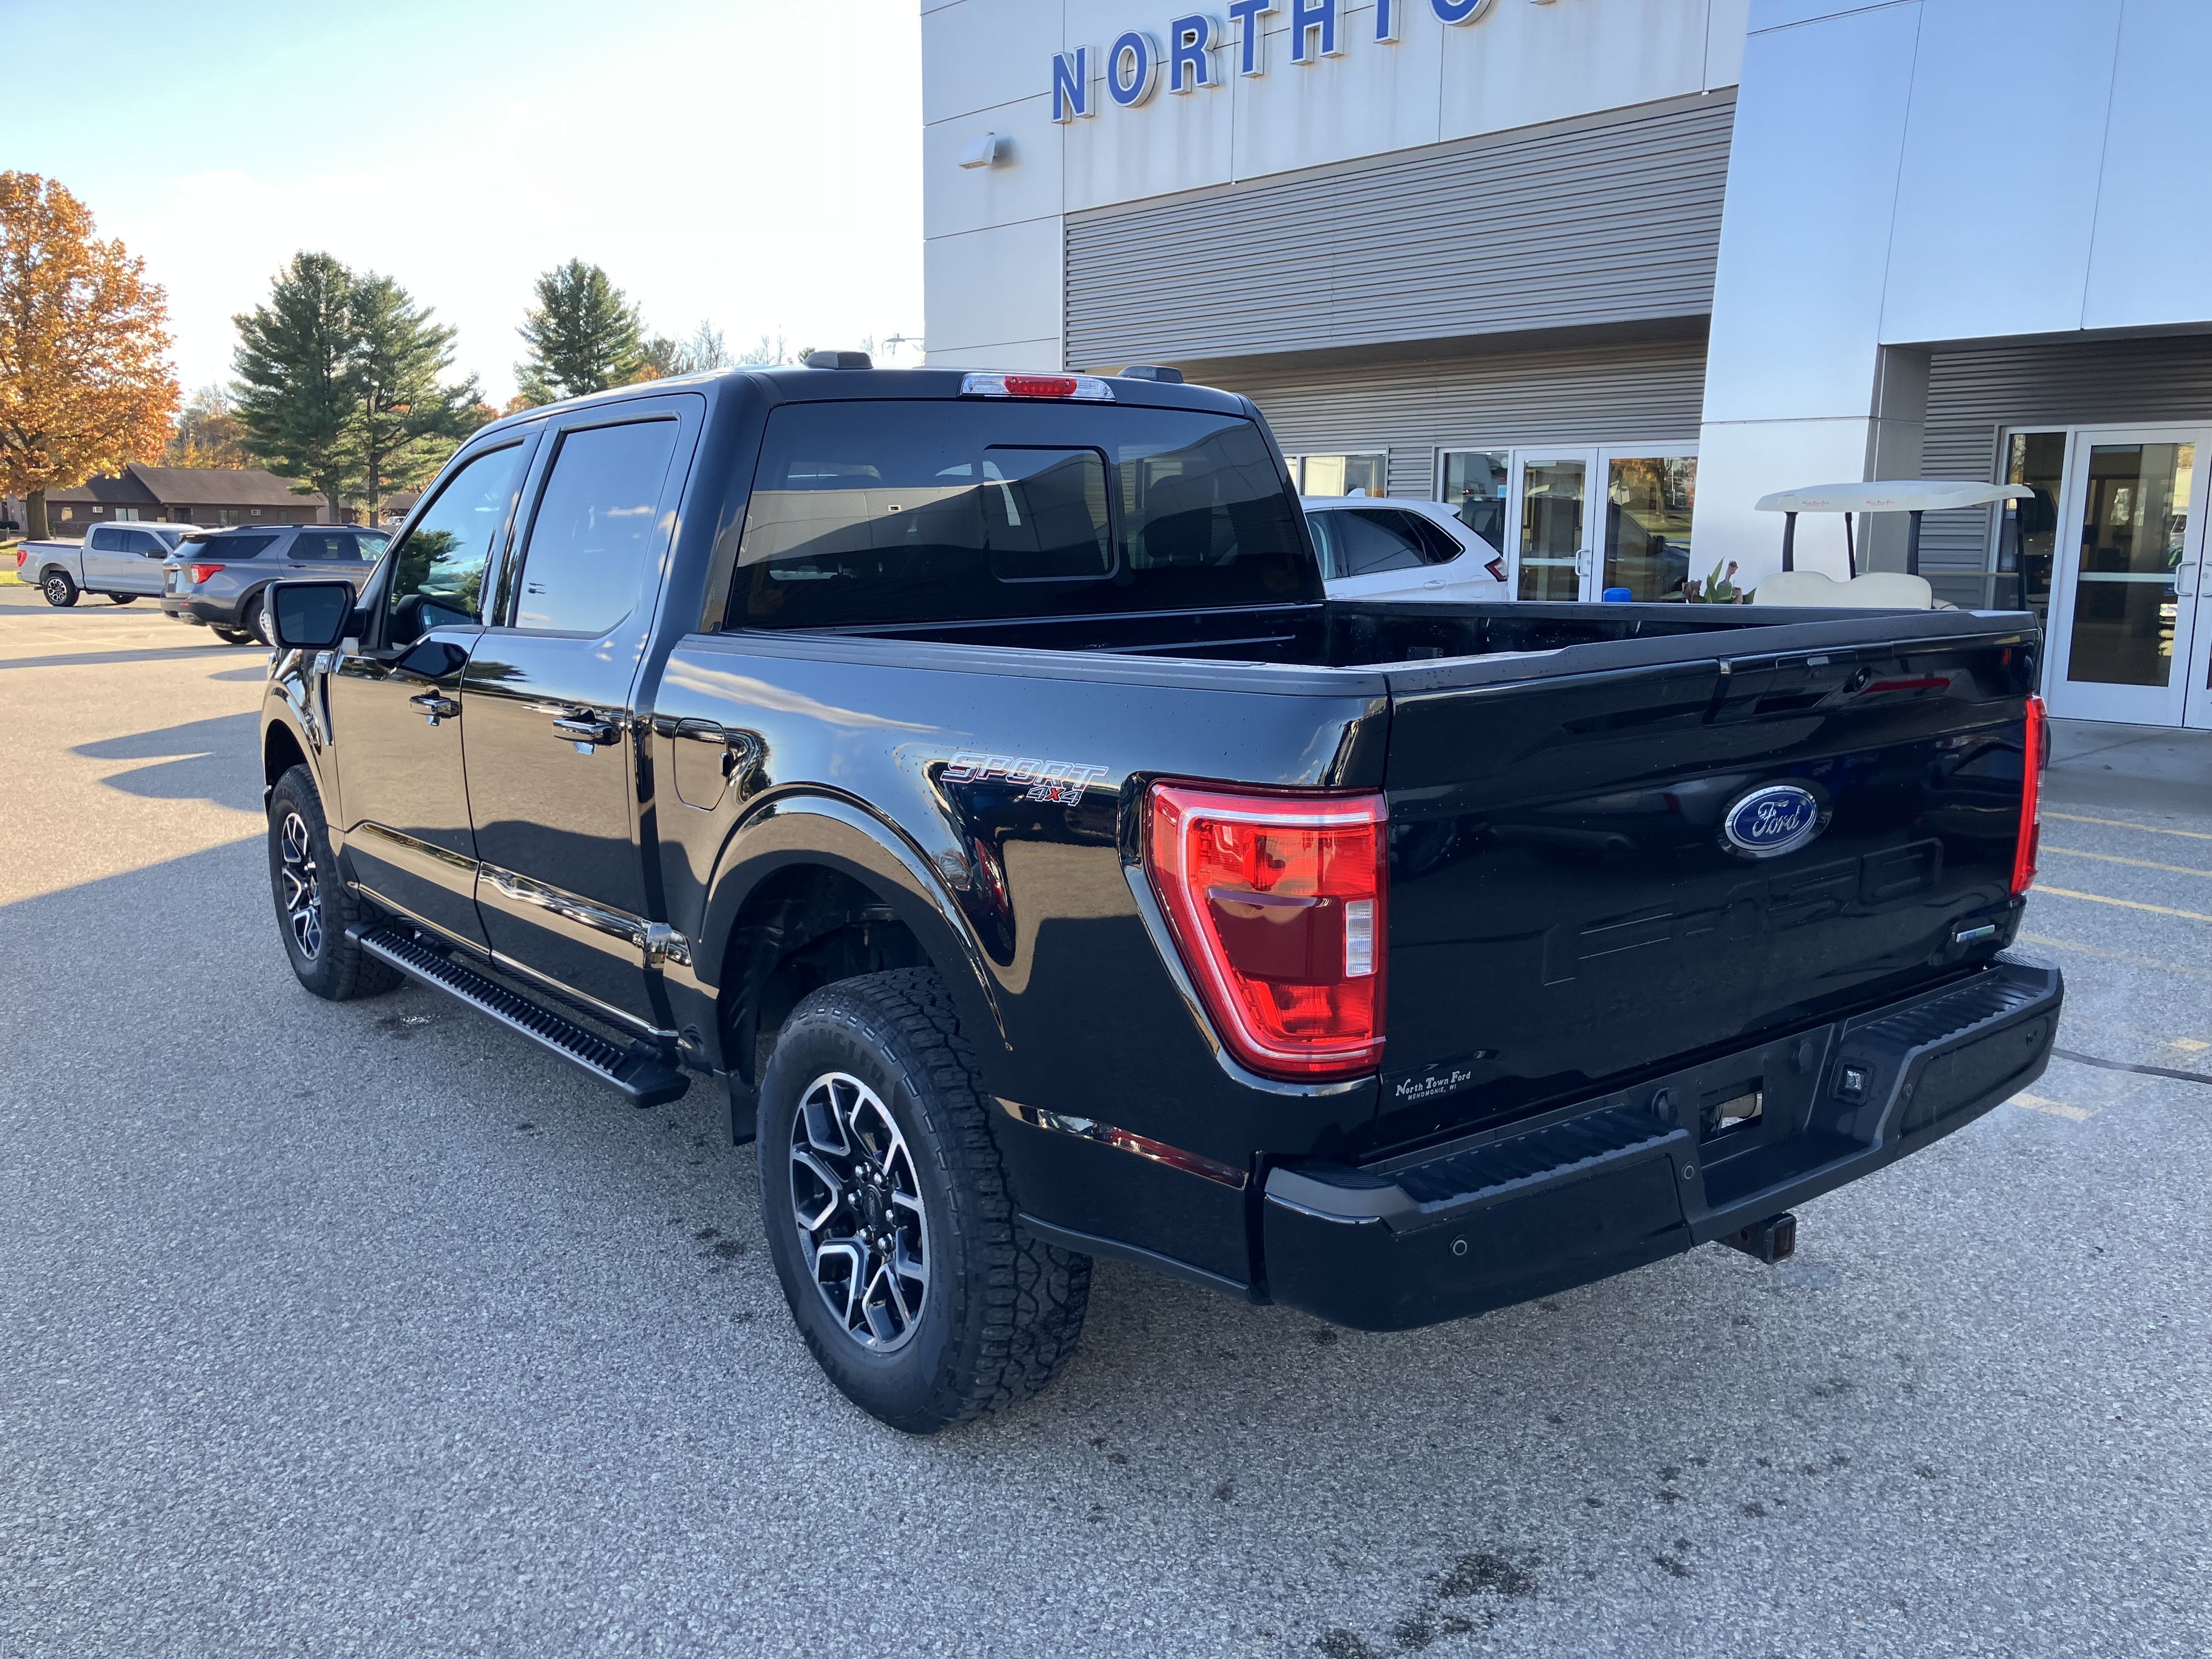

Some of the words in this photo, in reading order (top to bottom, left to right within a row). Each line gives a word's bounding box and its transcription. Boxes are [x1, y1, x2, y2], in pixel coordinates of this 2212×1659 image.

[940, 751, 1109, 790] SPORT
[1752, 800, 1801, 837] Ford
[1396, 1079, 1423, 1097] North
[1426, 1076, 1449, 1089] Town
[1451, 1071, 1471, 1084] Ford
